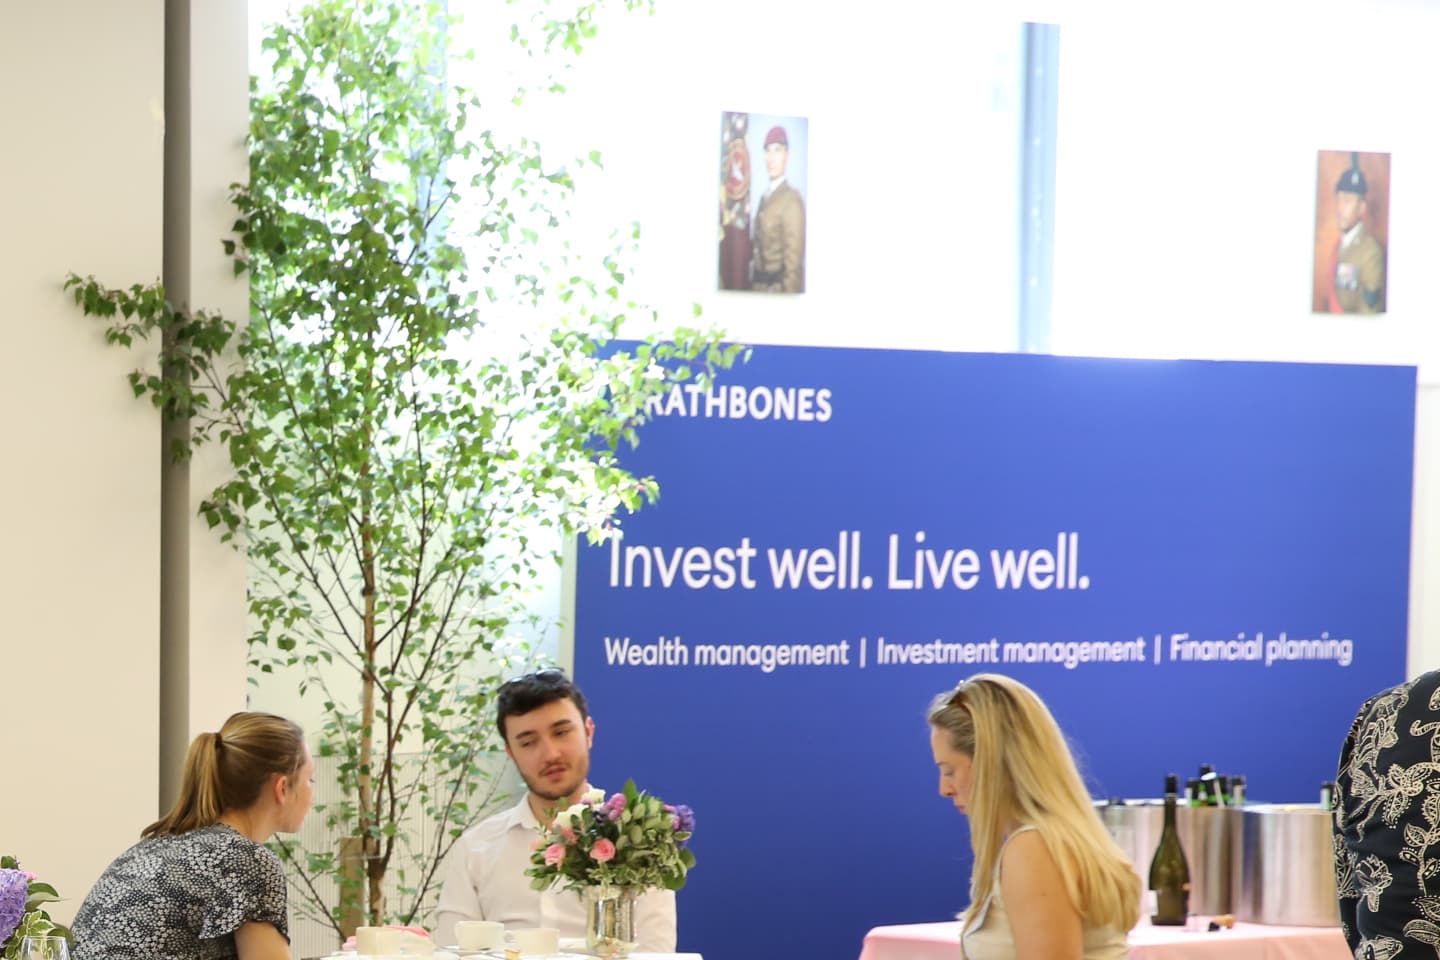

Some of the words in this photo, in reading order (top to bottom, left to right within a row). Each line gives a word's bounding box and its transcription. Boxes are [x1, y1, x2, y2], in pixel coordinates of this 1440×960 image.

[608, 530, 756, 589] Invest
[767, 530, 873, 590] well.
[888, 530, 980, 590] Live
[990, 531, 1090, 590] well.
[603, 636, 689, 666] Wealth
[694, 640, 850, 674] management
[877, 636, 999, 666] Investment
[1002, 636, 1147, 670] management
[1170, 632, 1264, 662] Financial
[1265, 631, 1354, 667] planning
